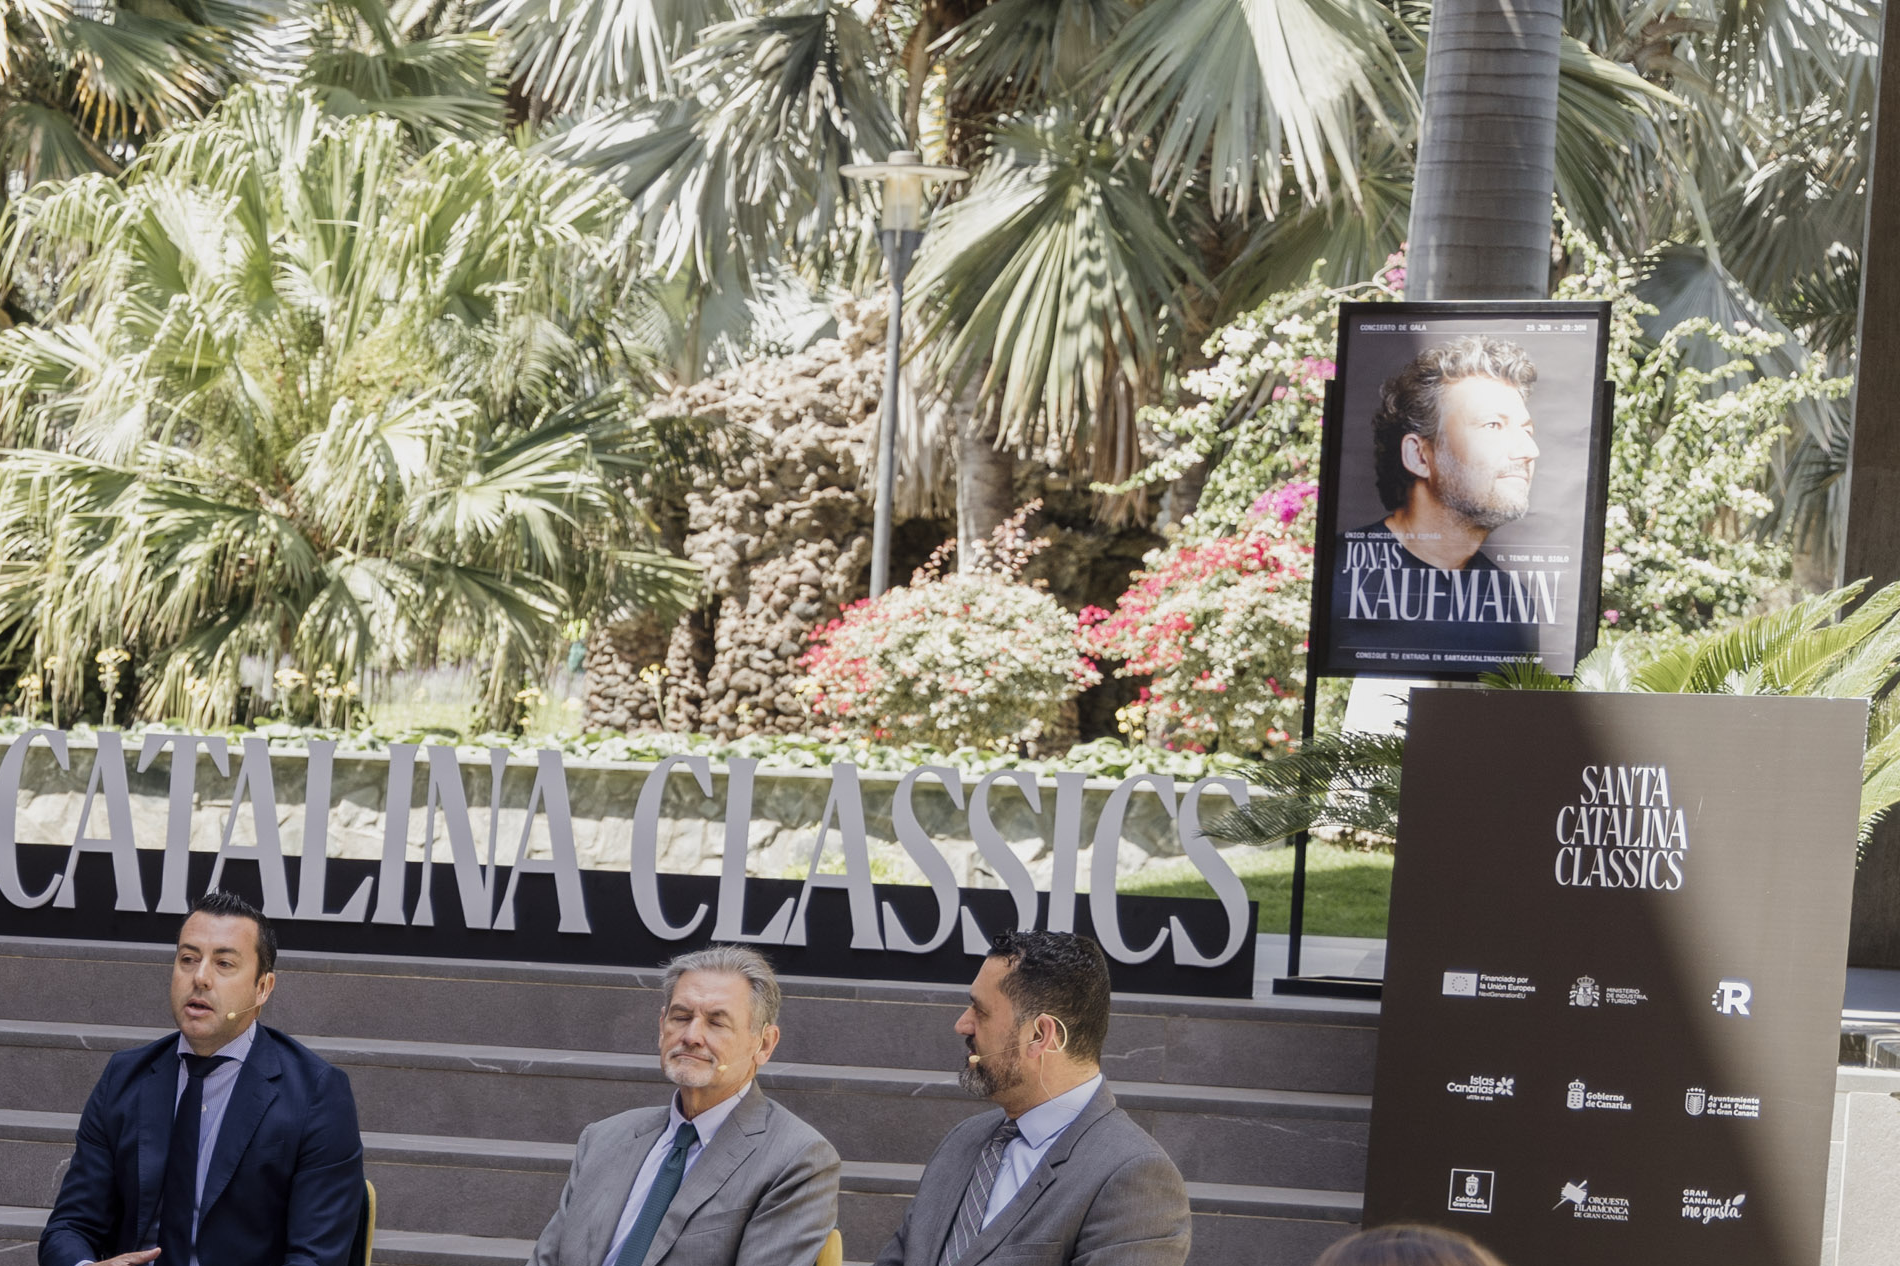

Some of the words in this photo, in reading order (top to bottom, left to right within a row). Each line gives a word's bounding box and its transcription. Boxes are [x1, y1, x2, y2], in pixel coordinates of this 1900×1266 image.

[1345, 531, 1365, 539] ÚNICO
[1342, 542, 1403, 574] JONAS
[1348, 567, 1561, 624] KAUFMANN
[1402, 653, 1430, 661] ENTRADA
[1580, 766, 1669, 807] SANTA
[1556, 806, 1687, 849] CATALINA
[630, 755, 1250, 968] CLASSICS
[1555, 847, 1683, 890] CLASSICS
[1480, 974, 1516, 983] Financiado
[1508, 984, 1536, 992] Europea
[1470, 1075, 1495, 1085] Islas
[1446, 1082, 1494, 1094] Canarias
[1586, 1092, 1624, 1101] Gobierno
[1708, 1095, 1760, 1104] Ayuntamiento
[1585, 1100, 1595, 1108] de
[1596, 1101, 1632, 1110] Canarias
[1734, 1109, 1759, 1117] Canaria
[1683, 1189, 1708, 1197] GRAN
[1588, 1197, 1630, 1206] ORQUESTA
[1682, 1197, 1721, 1206] CANARIA
[1682, 1205, 1701, 1218] me
[1702, 1199, 1742, 1224] gusta
